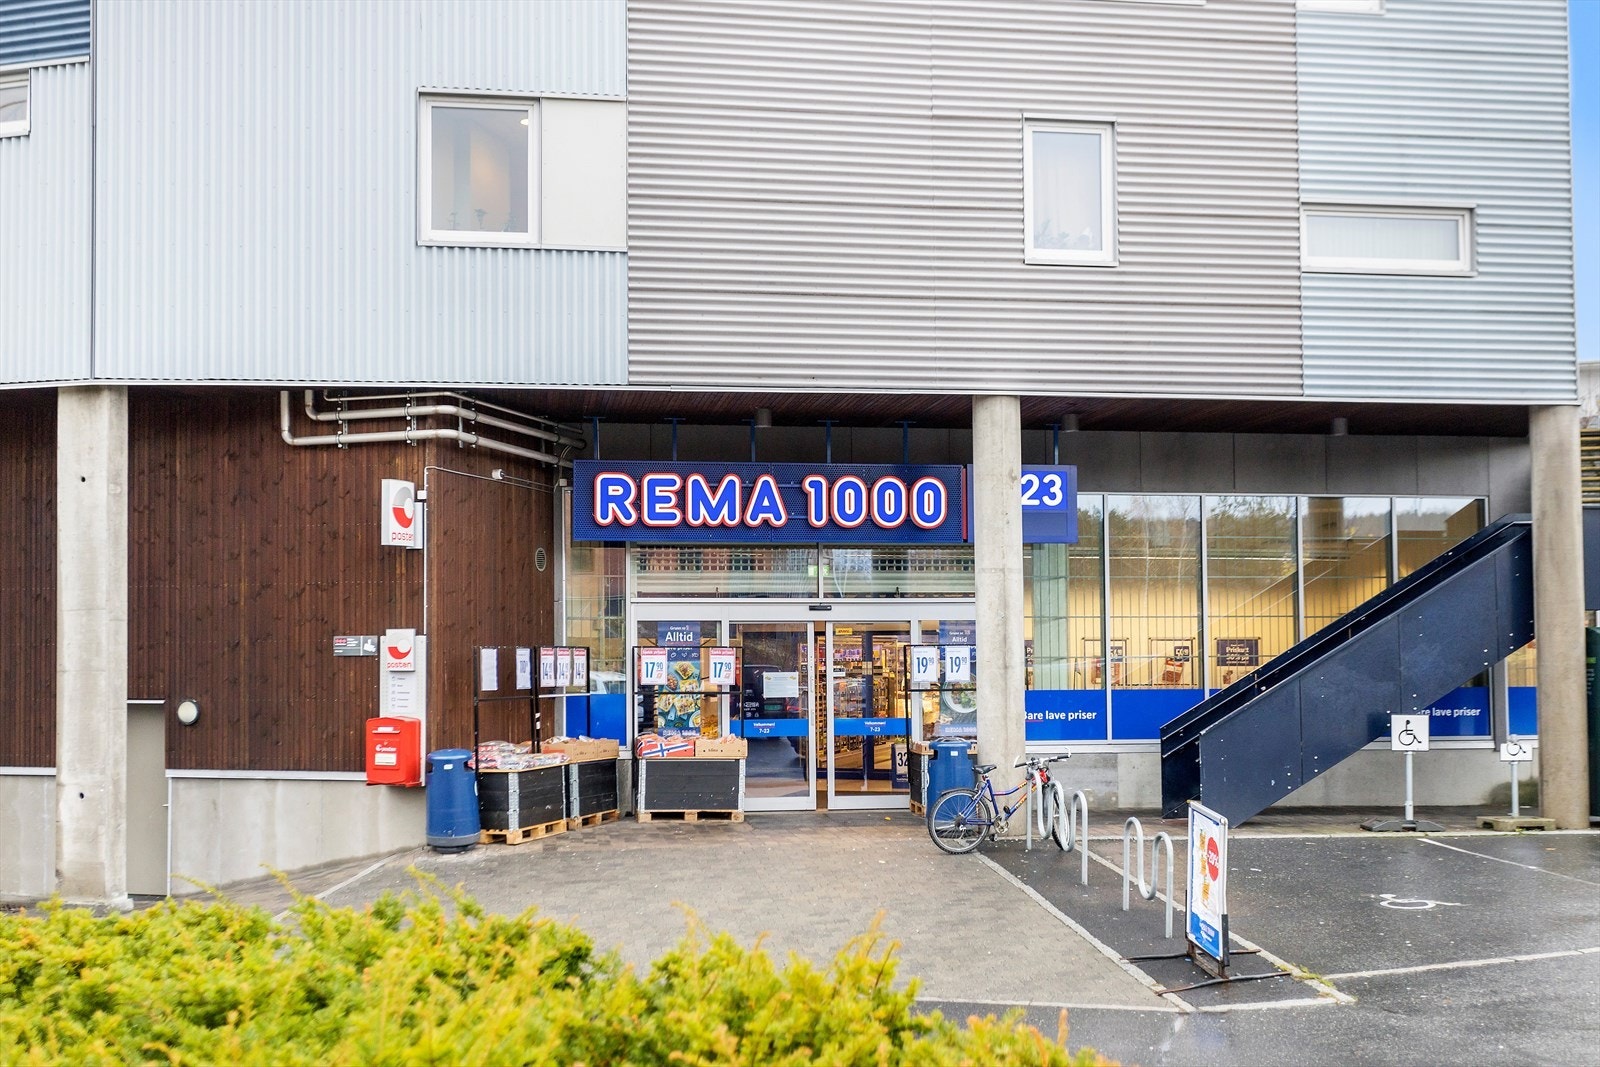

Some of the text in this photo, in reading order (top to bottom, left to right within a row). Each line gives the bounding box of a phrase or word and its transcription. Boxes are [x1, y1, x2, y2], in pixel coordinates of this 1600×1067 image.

[1021, 473, 1063, 507] 23
[594, 471, 947, 530] REMA 1000
[665, 631, 693, 642] Alltid
[645, 662, 656, 678] 17
[713, 662, 724, 678] 17
[917, 657, 928, 674] 19
[950, 656, 961, 673] 19
[1045, 710, 1066, 720] lave
[1067, 709, 1097, 722] priser
[1432, 707, 1452, 717] lave
[1453, 706, 1481, 718] priser
